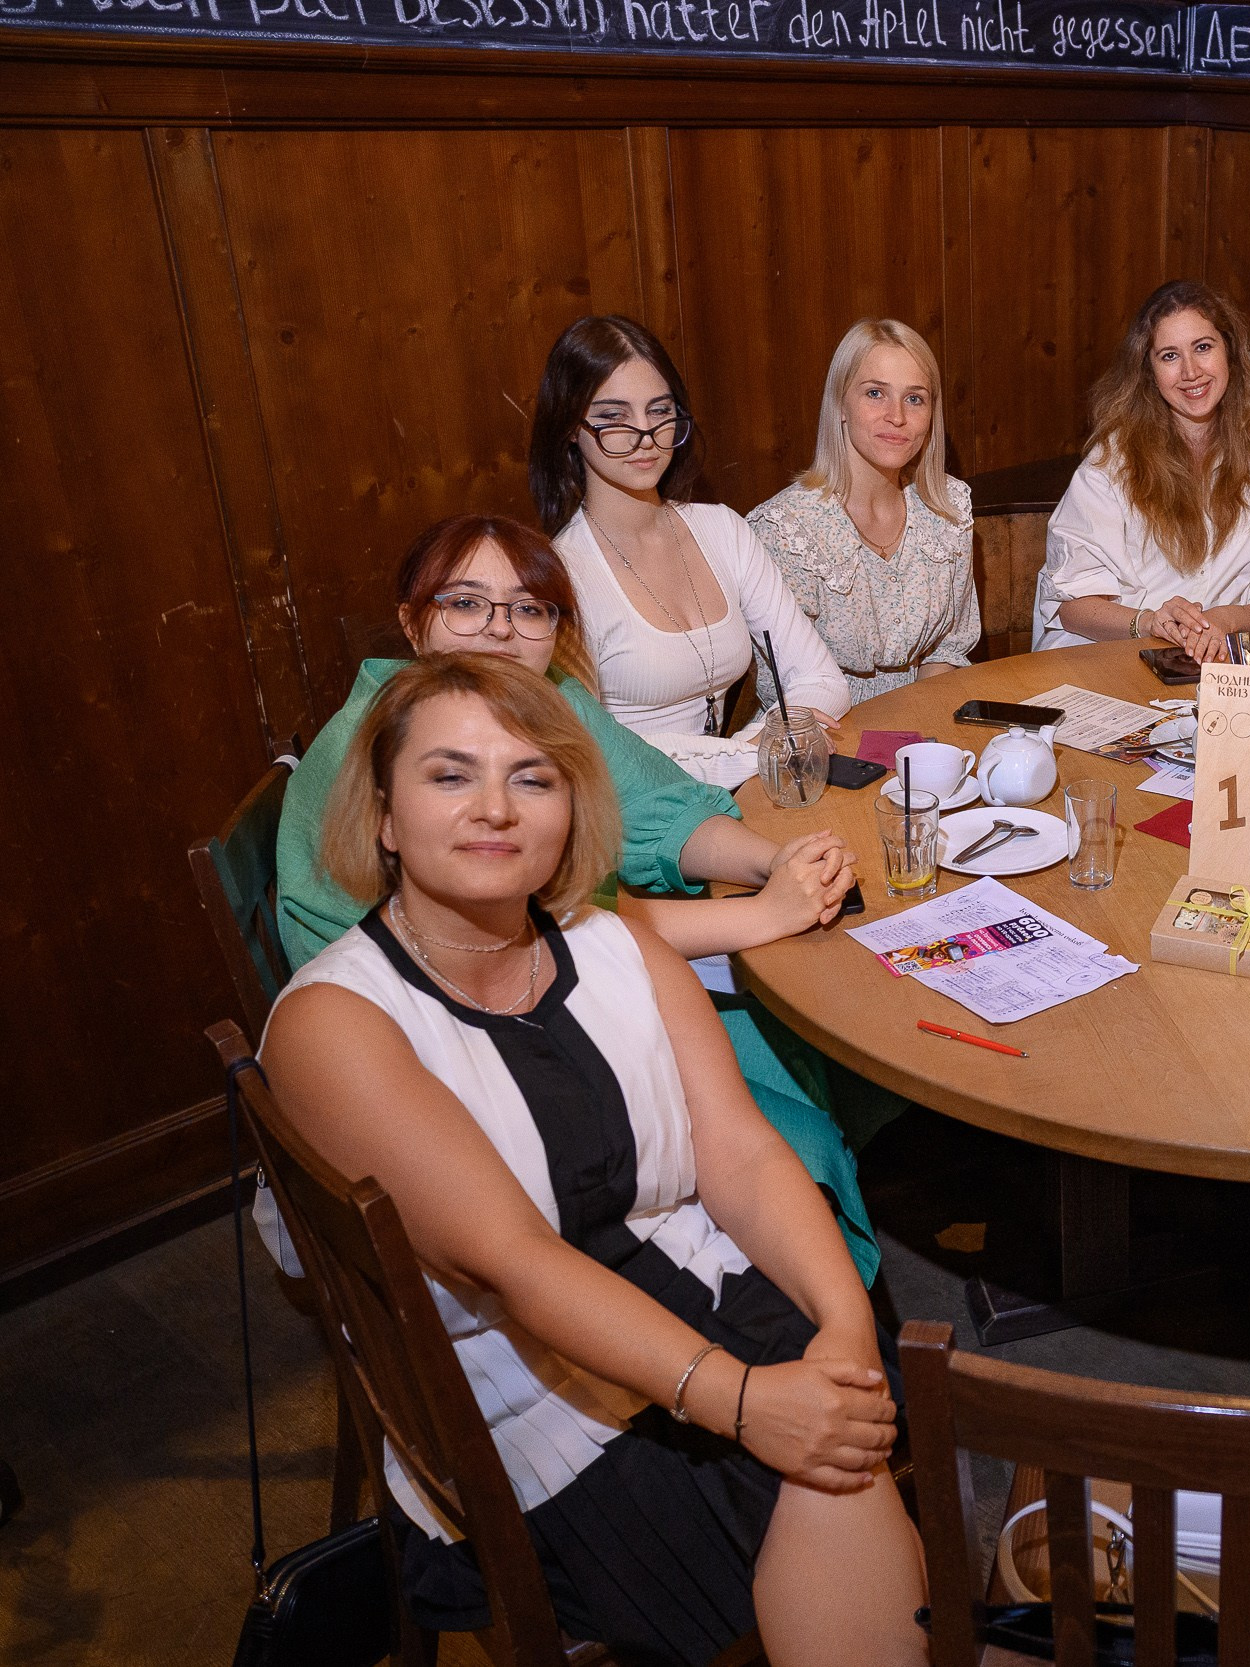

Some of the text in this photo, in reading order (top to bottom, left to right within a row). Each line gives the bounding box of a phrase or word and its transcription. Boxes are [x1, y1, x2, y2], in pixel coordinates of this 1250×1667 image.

[788, 0, 852, 49] den
[961, 0, 1035, 53] nicht
[1053, 10, 1182, 60] gegessen!
[1218, 686, 1249, 698] КВИЗ
[1018, 917, 1049, 938] 600
